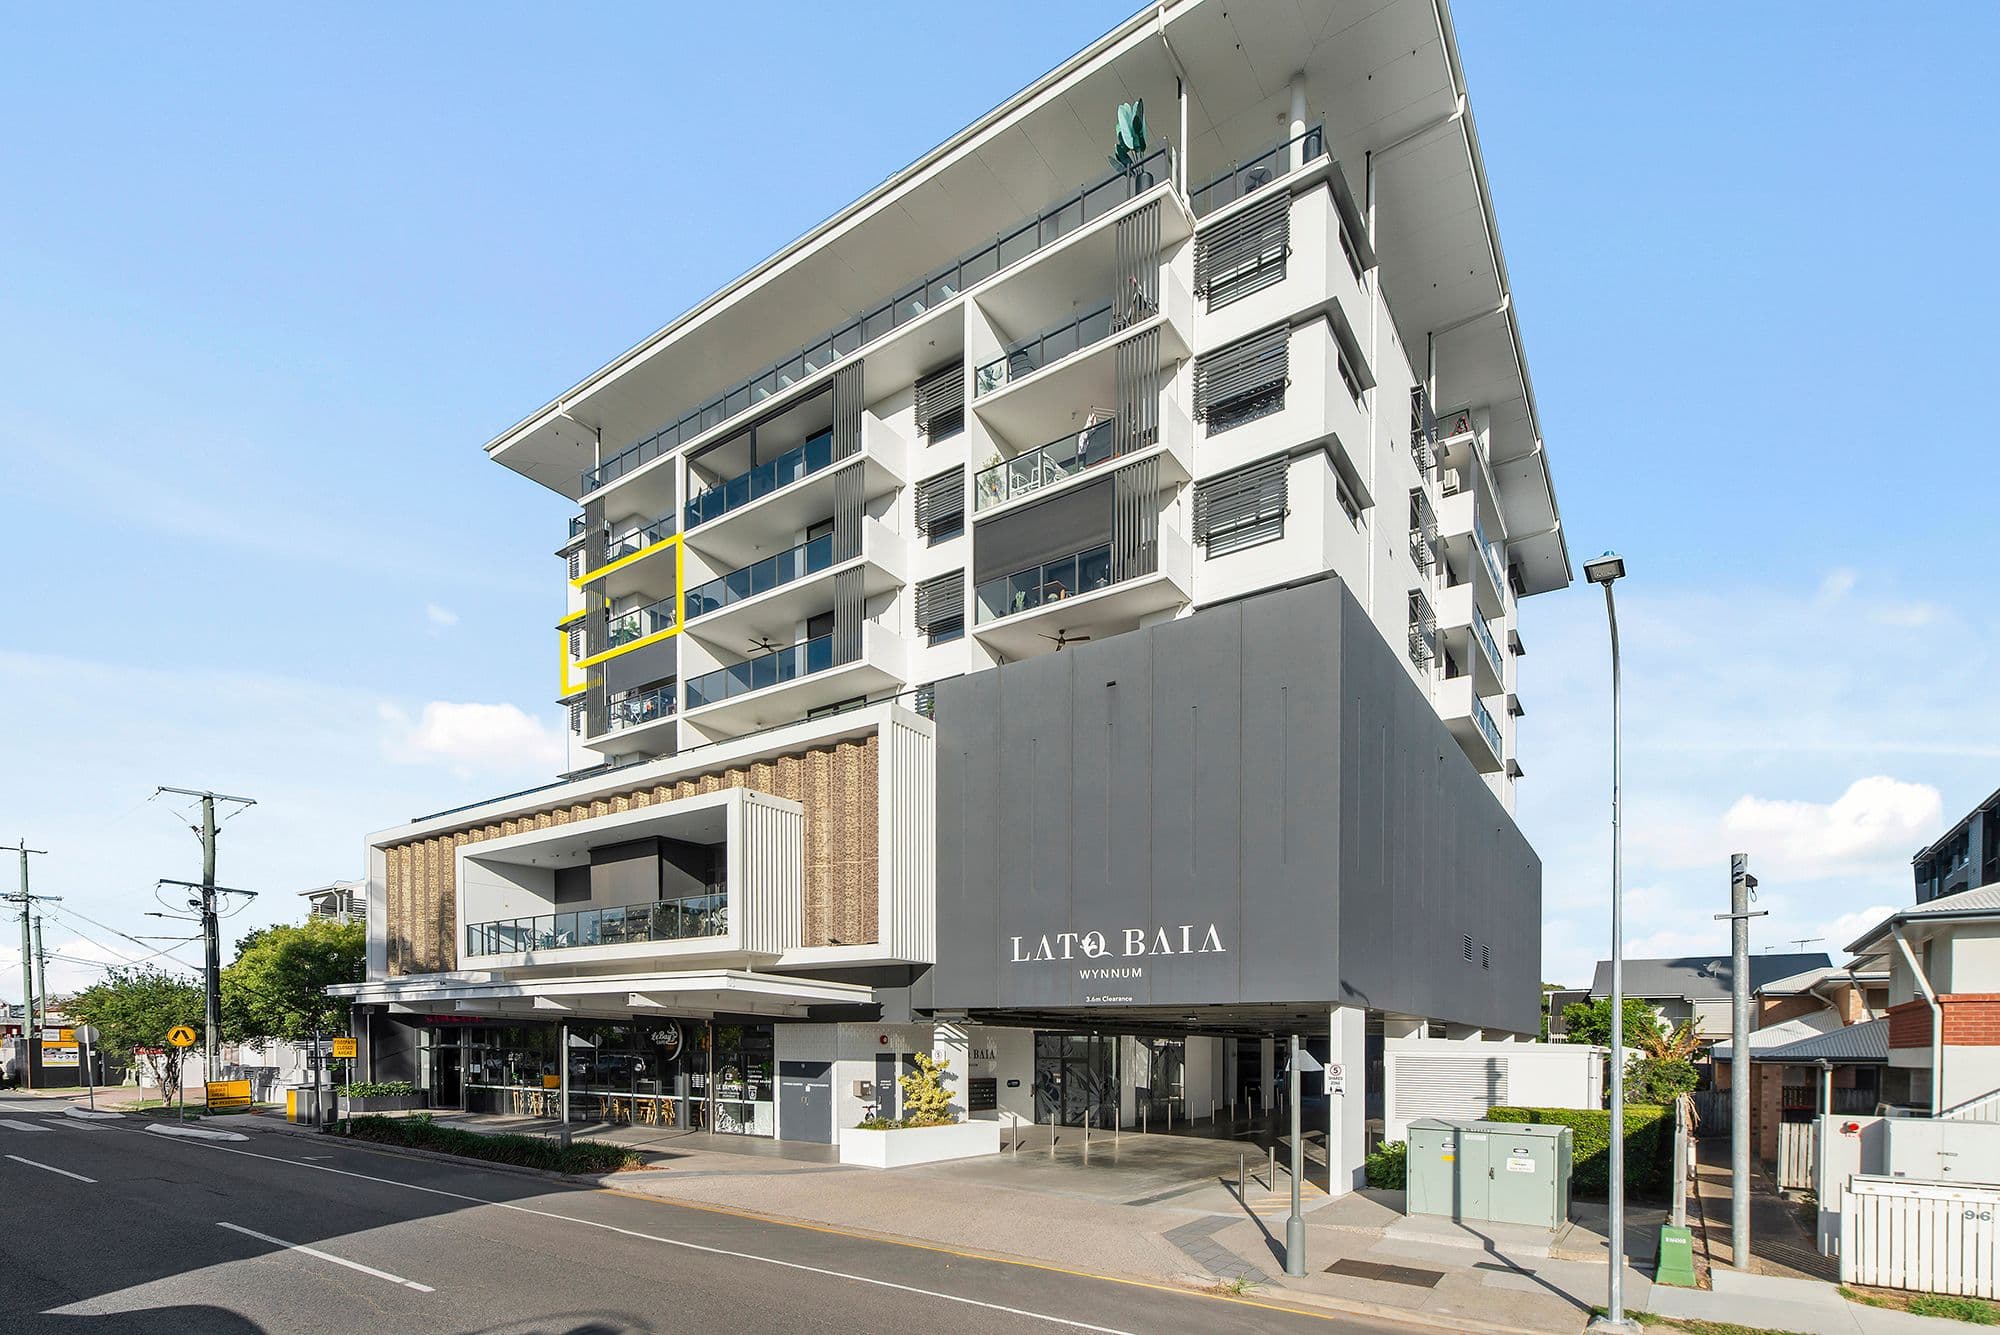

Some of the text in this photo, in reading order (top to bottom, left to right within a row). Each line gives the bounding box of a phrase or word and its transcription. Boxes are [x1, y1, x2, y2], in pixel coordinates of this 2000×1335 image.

[1010, 923, 1226, 962] LATO BAIA
[1079, 967, 1142, 980] WYNNUM
[1085, 994, 1133, 1003] 3.6m Clearance
[973, 1049, 995, 1060] BAIA
